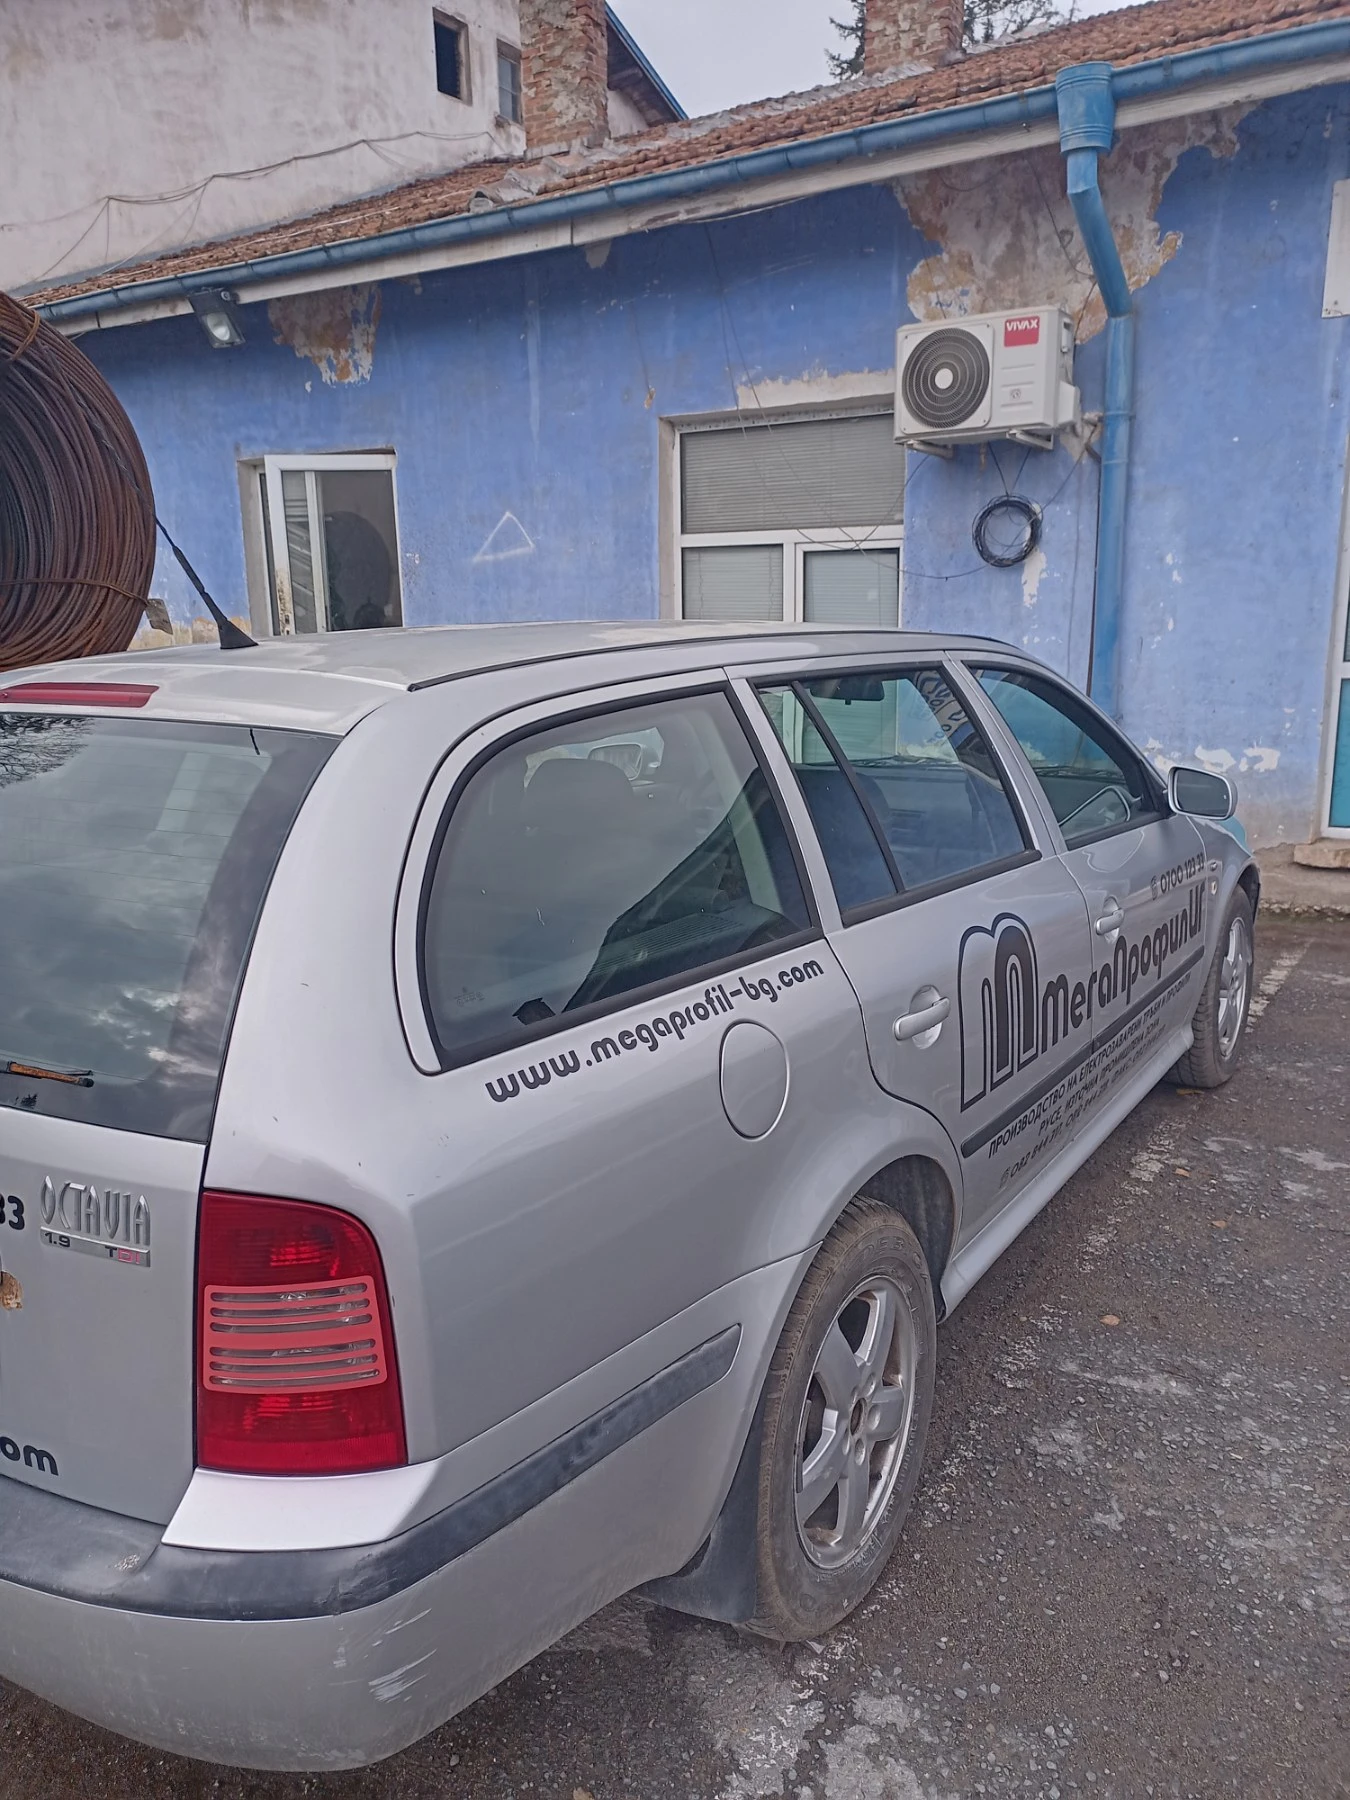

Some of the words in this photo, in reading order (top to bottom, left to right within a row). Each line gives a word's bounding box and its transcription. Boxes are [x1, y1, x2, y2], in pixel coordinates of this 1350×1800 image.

[1006, 319, 1039, 332] VIVAX
[1160, 864, 1184, 895] 0700
[1184, 856, 1196, 880] 123
[484, 958, 825, 1103] www.megaprofil-bg.com
[988, 1083, 1066, 1159] ПРОИЗВОДСТВО
[1066, 1074, 1078, 1092] НА
[40, 1174, 151, 1247] OCTAVIA
[45, 1232, 71, 1248] 1.9
[105, 1245, 140, 1265] TDI
[0, 1436, 59, 1477] om
